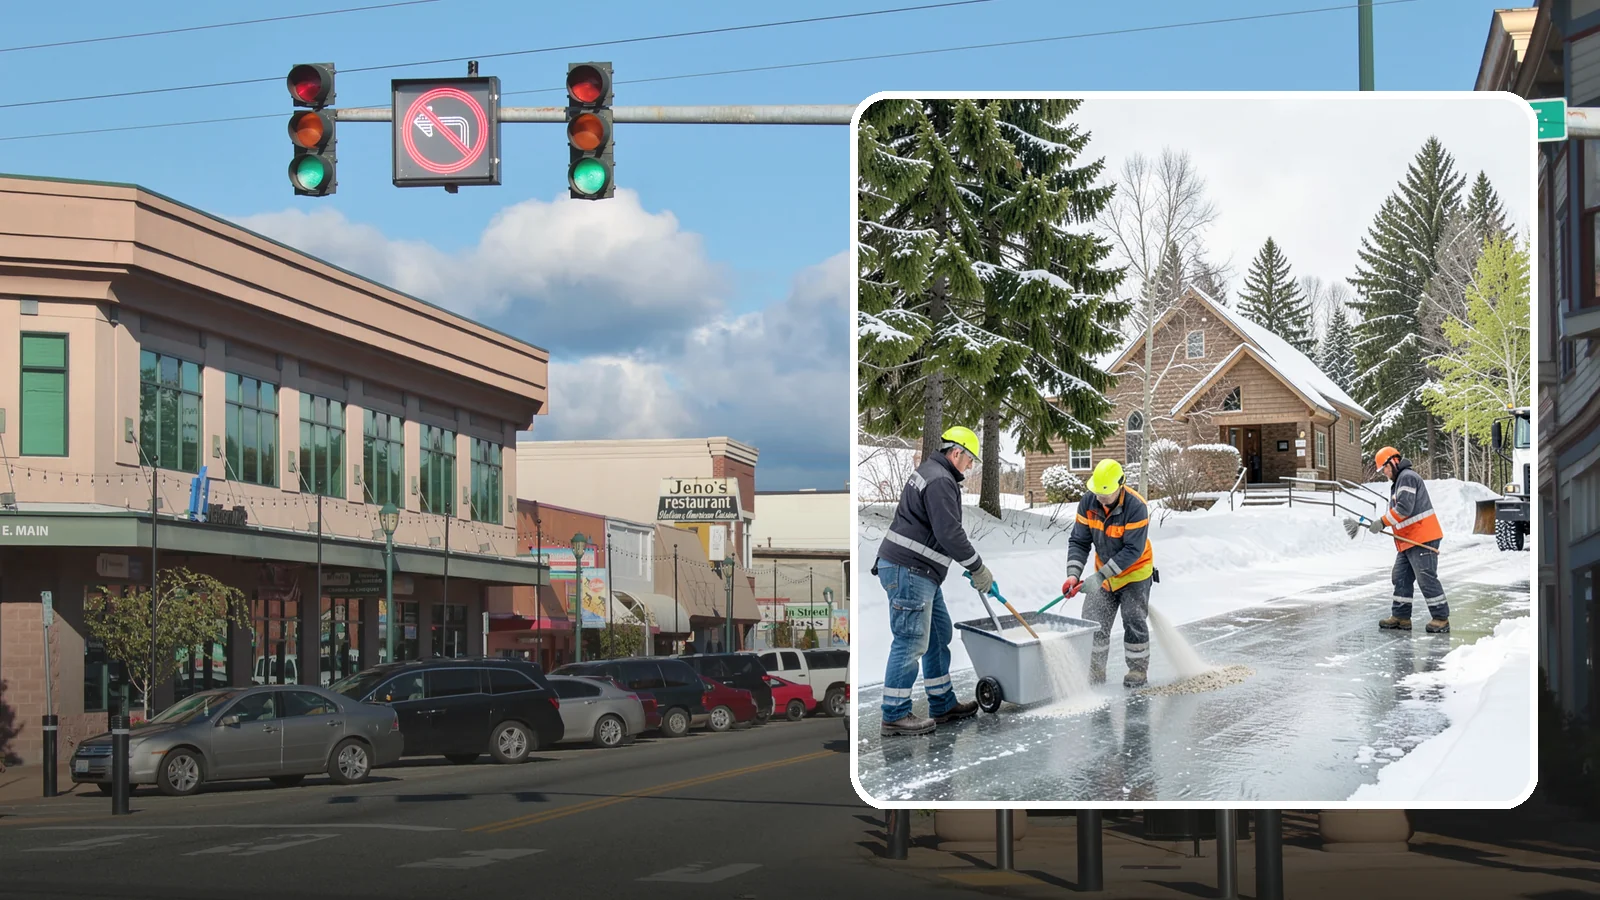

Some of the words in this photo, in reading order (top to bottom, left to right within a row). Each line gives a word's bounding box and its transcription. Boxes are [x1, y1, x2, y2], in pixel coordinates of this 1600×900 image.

[669, 480, 727, 494] Jeno's
[665, 496, 731, 509] restaurant
[658, 510, 681, 520] Italian
[686, 509, 714, 519] American
[715, 509, 737, 519] Cuisine
[2, 525, 13, 536] E.
[15, 525, 49, 536] MAIN
[785, 607, 795, 616] in
[797, 607, 828, 616] Street
[789, 619, 823, 627] lass
